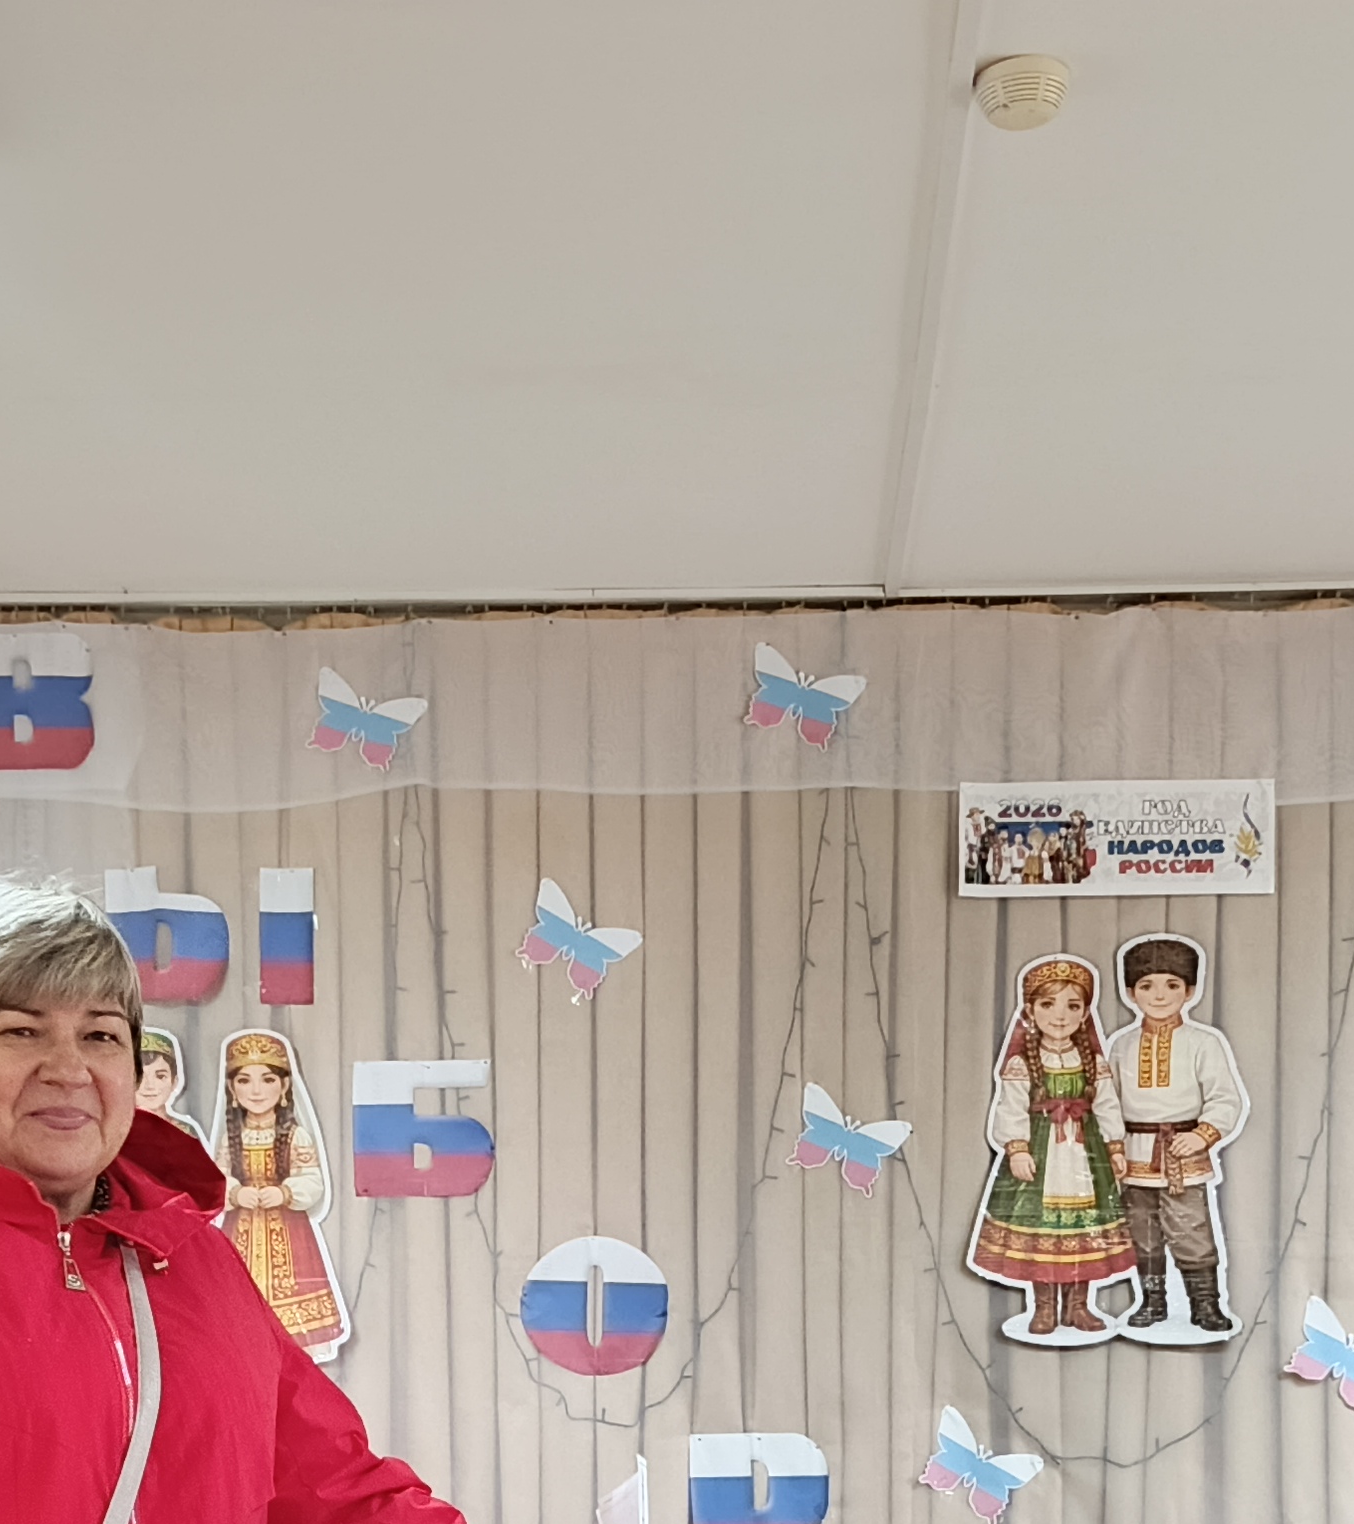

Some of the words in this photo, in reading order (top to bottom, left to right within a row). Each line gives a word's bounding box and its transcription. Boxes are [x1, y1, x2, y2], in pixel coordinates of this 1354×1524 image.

[997, 797, 1062, 819] 2026
[1141, 799, 1191, 818] ГОД
[1096, 818, 1226, 839] ЕДИНСТВА
[1107, 839, 1226, 857] НАРОДОВ
[1118, 858, 1214, 875] РОССИИ
